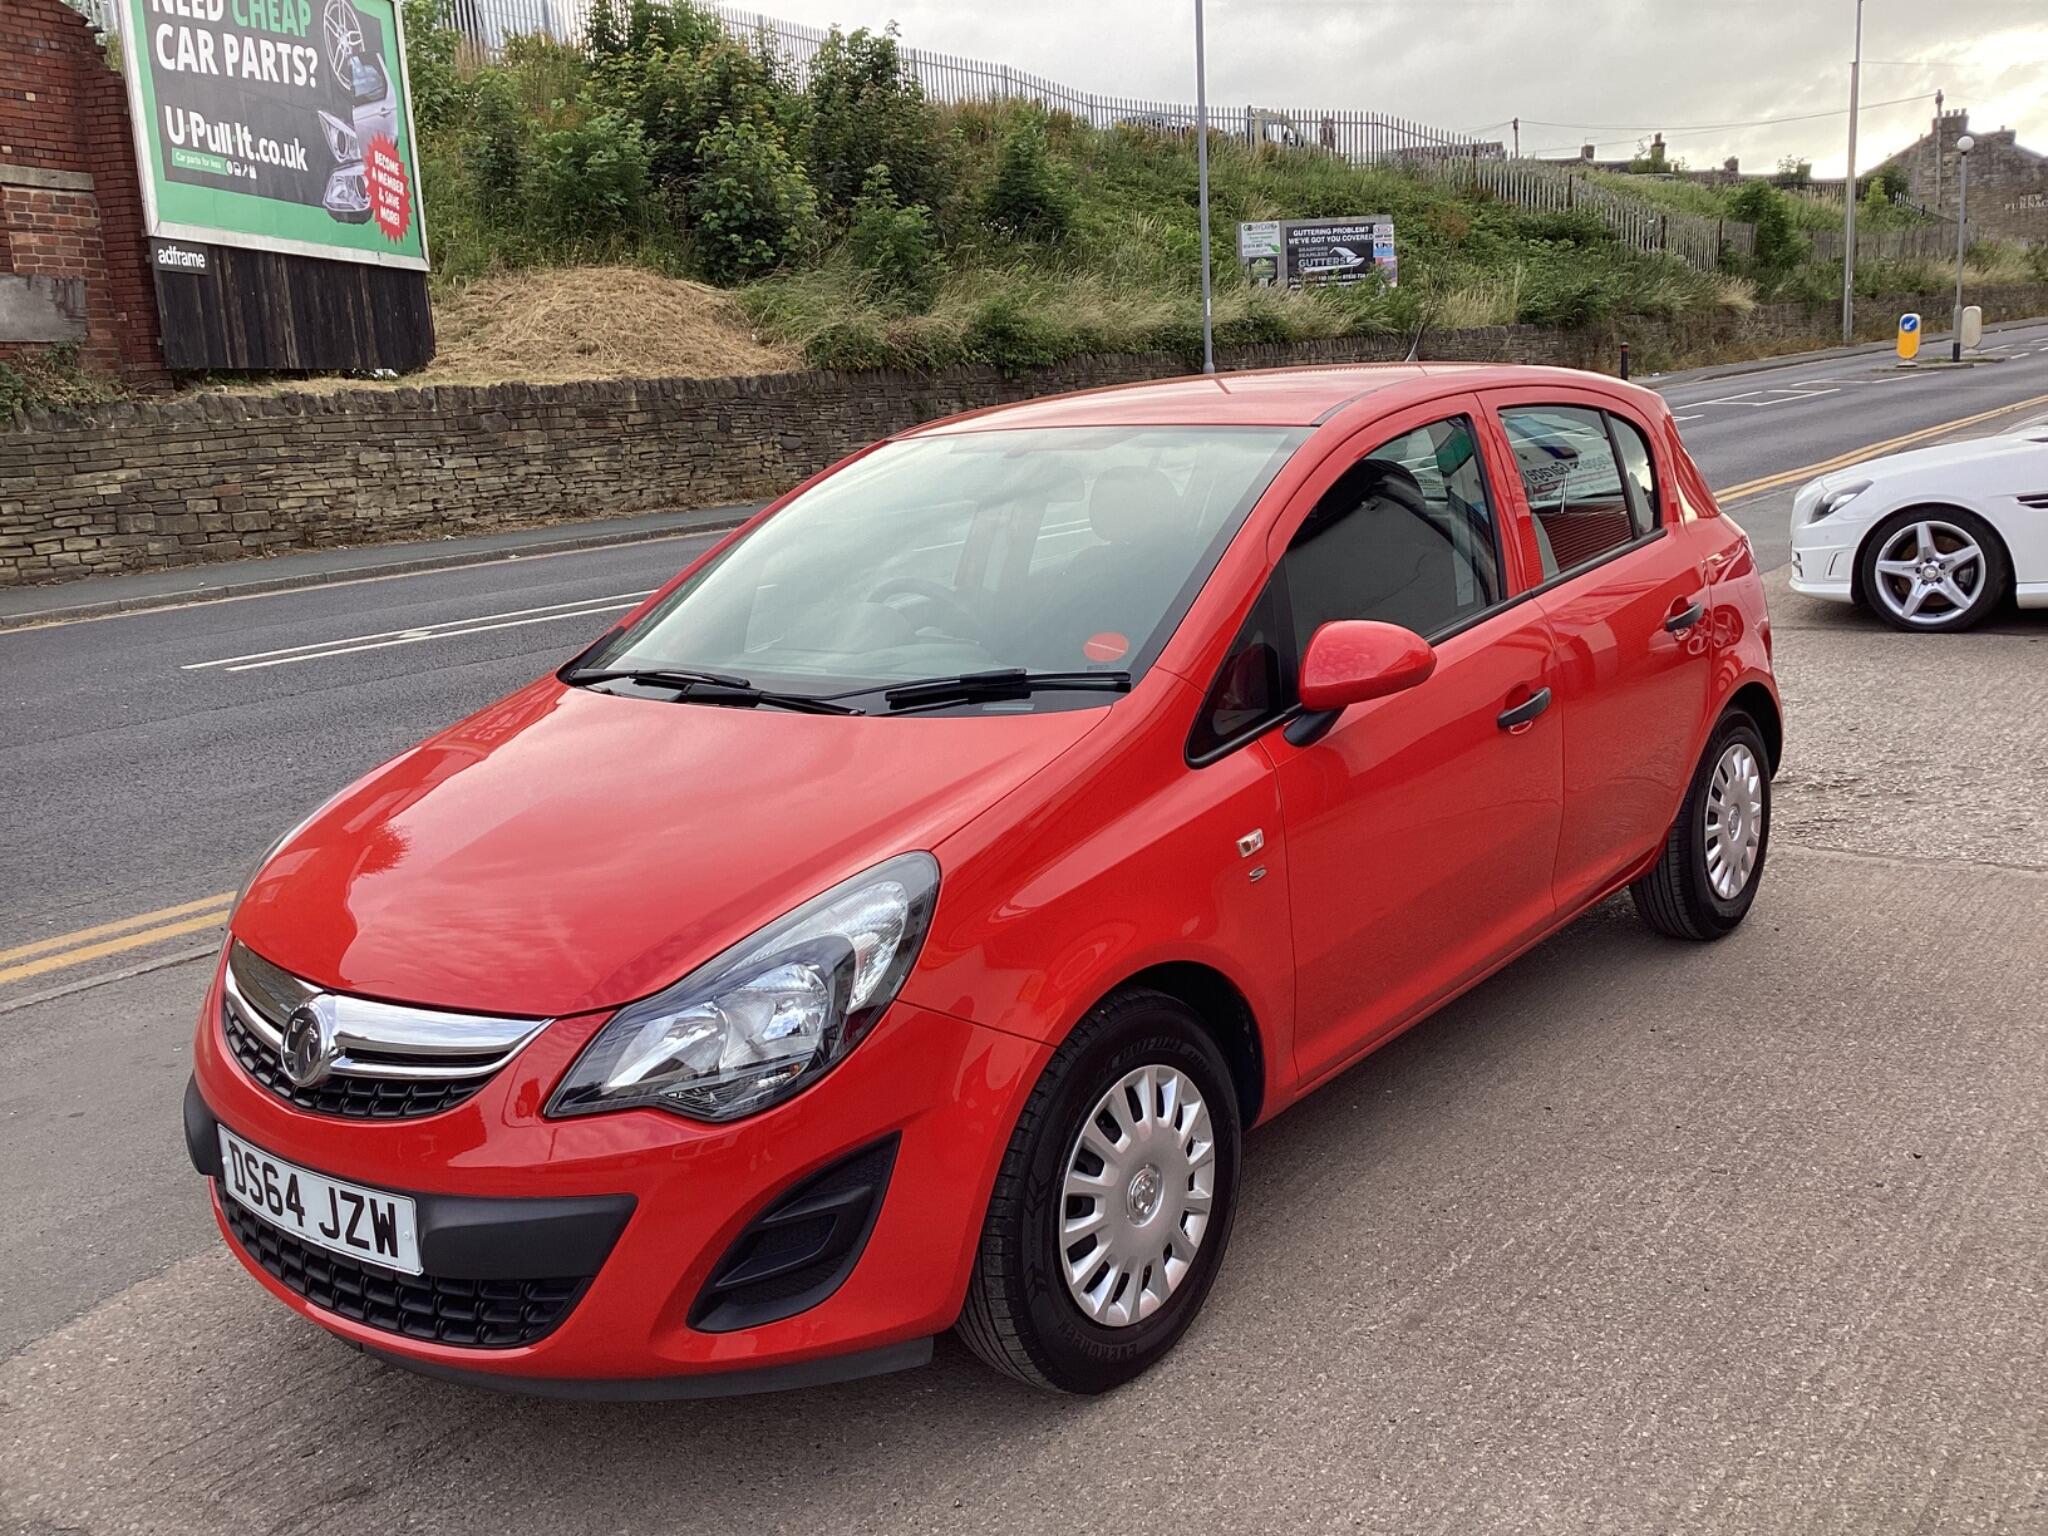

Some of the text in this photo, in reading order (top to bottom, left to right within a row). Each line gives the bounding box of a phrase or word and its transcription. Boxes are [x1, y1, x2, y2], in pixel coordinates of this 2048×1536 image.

[156, 23, 318, 88] CAR PARTS?
[1293, 228, 1332, 237] GUTTERING
[1332, 226, 1369, 235] PROBLEM?
[1310, 236, 1326, 244] GOT
[1326, 235, 1341, 243] YOU
[1342, 233, 1374, 242] COVERED
[157, 245, 206, 268] adframe
[1298, 257, 1346, 267] GUTTERS
[228, 1139, 399, 1259] DS64 JZW
